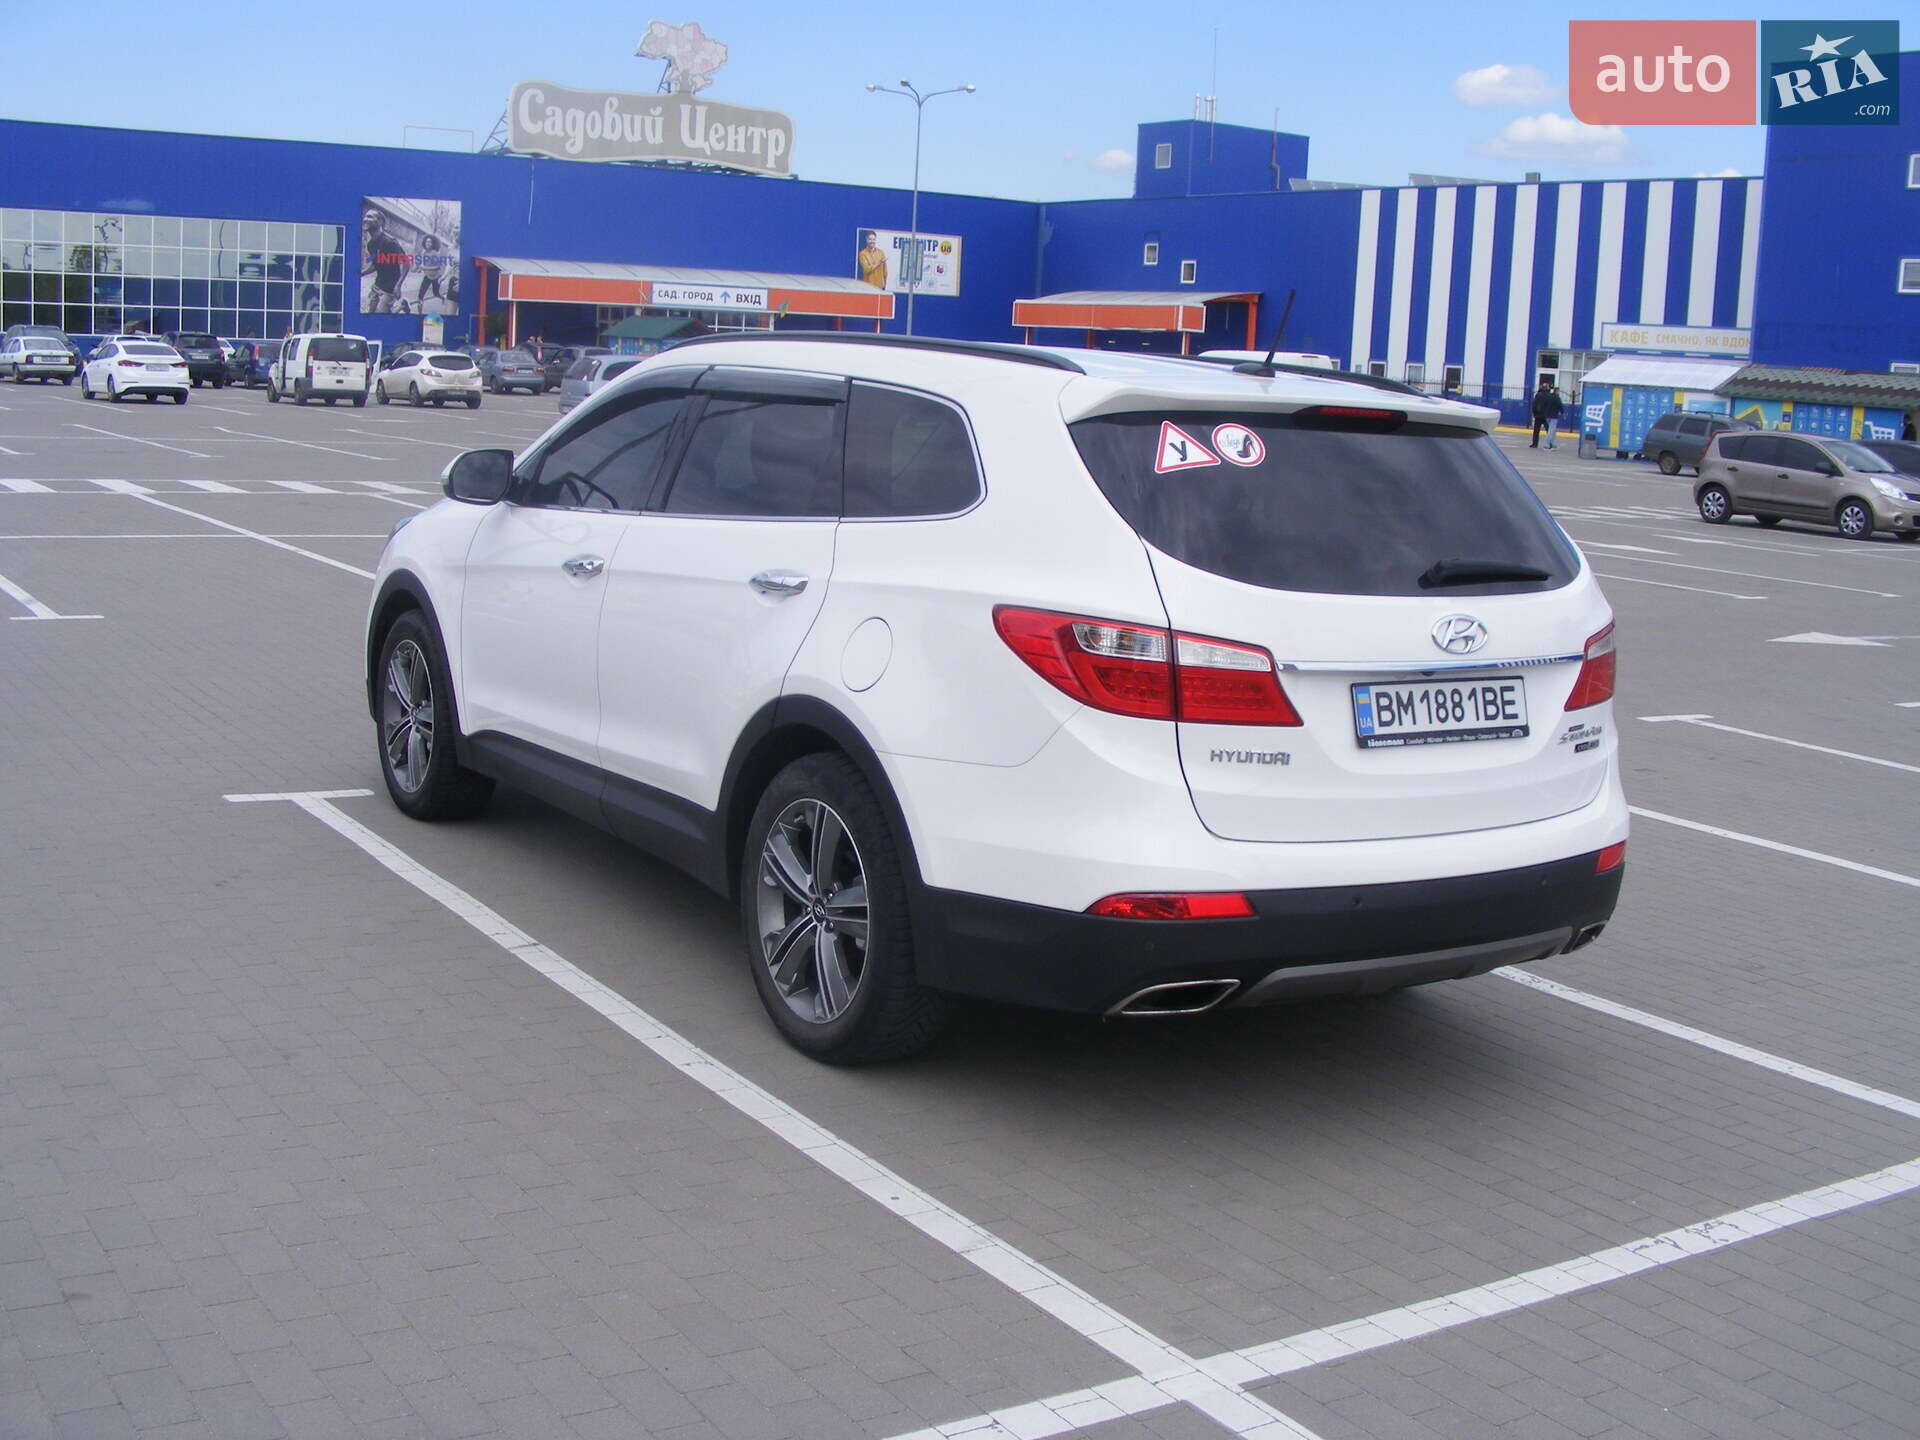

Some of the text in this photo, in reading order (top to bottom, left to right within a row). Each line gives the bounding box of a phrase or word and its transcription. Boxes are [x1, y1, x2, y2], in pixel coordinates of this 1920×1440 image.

[519, 88, 786, 169] Садовий Центр
[683, 291, 713, 302] ГОРОД
[735, 293, 762, 305] ВХІД
[1610, 330, 1649, 345] КАФЕ
[1360, 717, 1373, 728] UA
[1210, 749, 1291, 766] HYUNDAI
